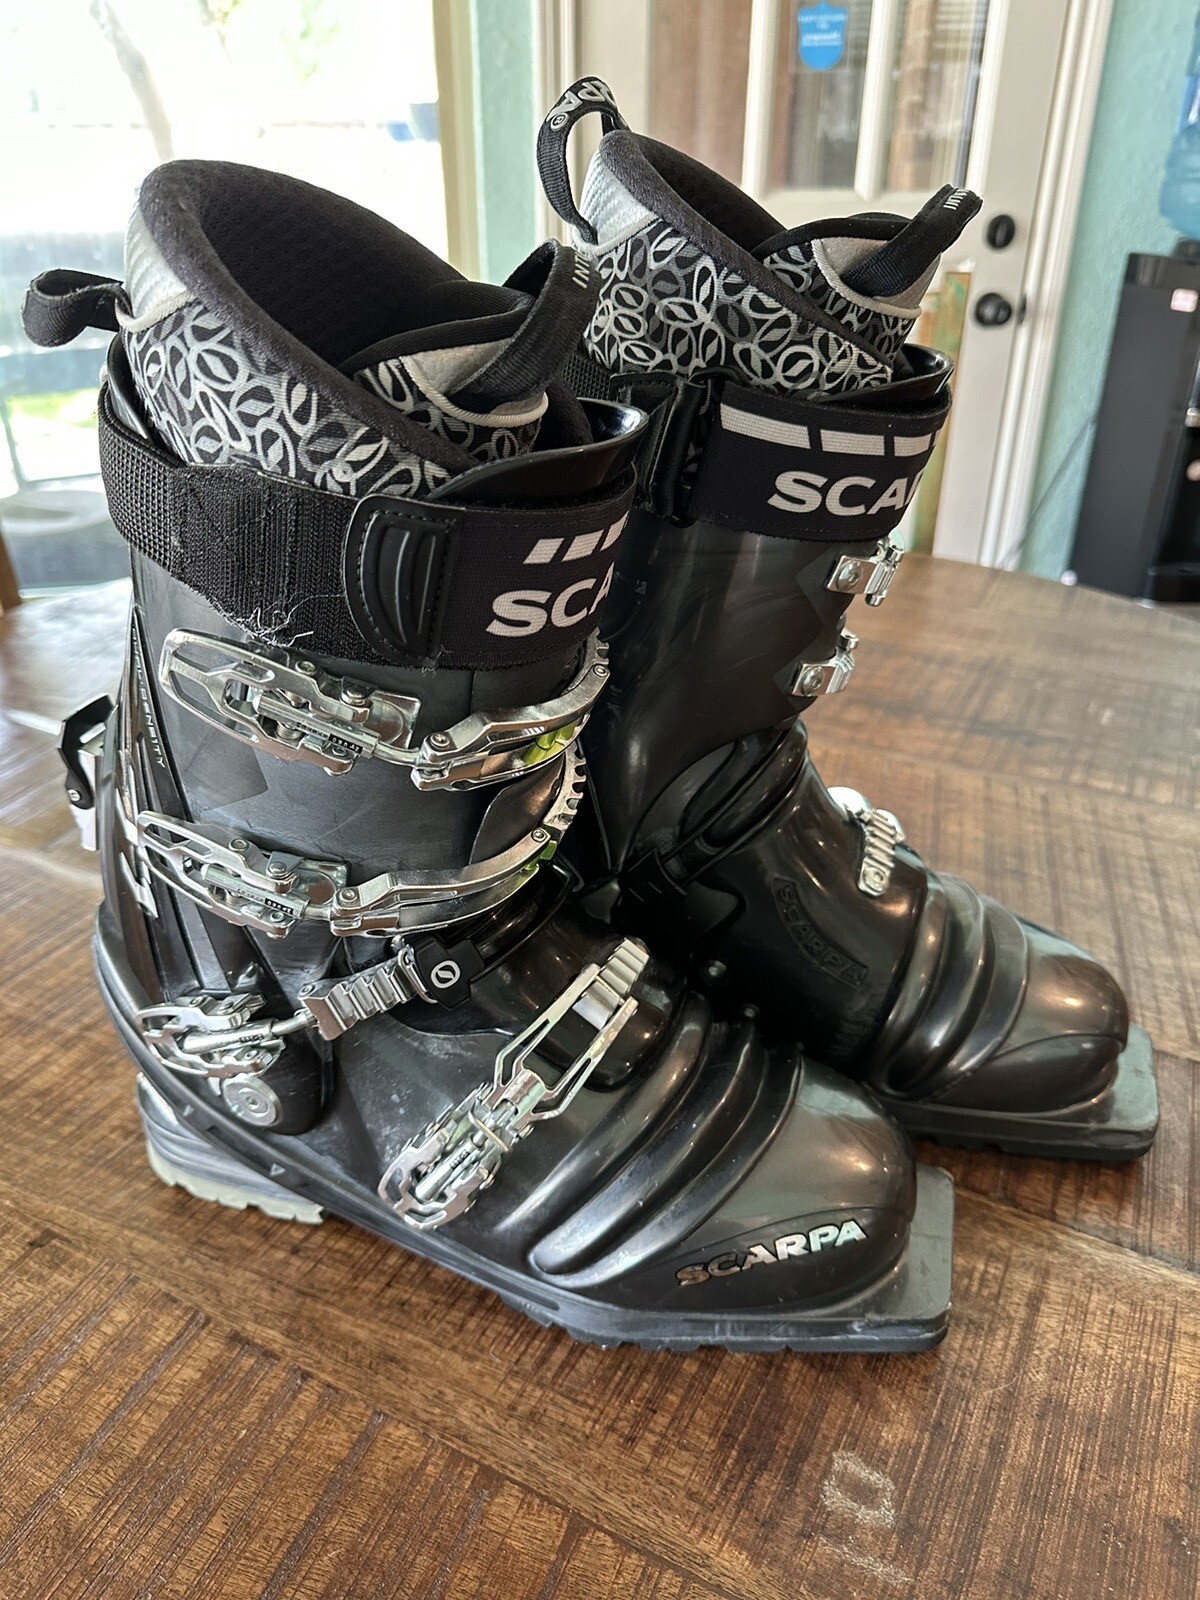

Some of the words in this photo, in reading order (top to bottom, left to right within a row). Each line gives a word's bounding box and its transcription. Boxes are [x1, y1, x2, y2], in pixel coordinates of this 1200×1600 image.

[767, 470, 924, 516] SCA
[778, 882, 866, 986] SCARPA
[675, 1219, 869, 1287] SCARPA
